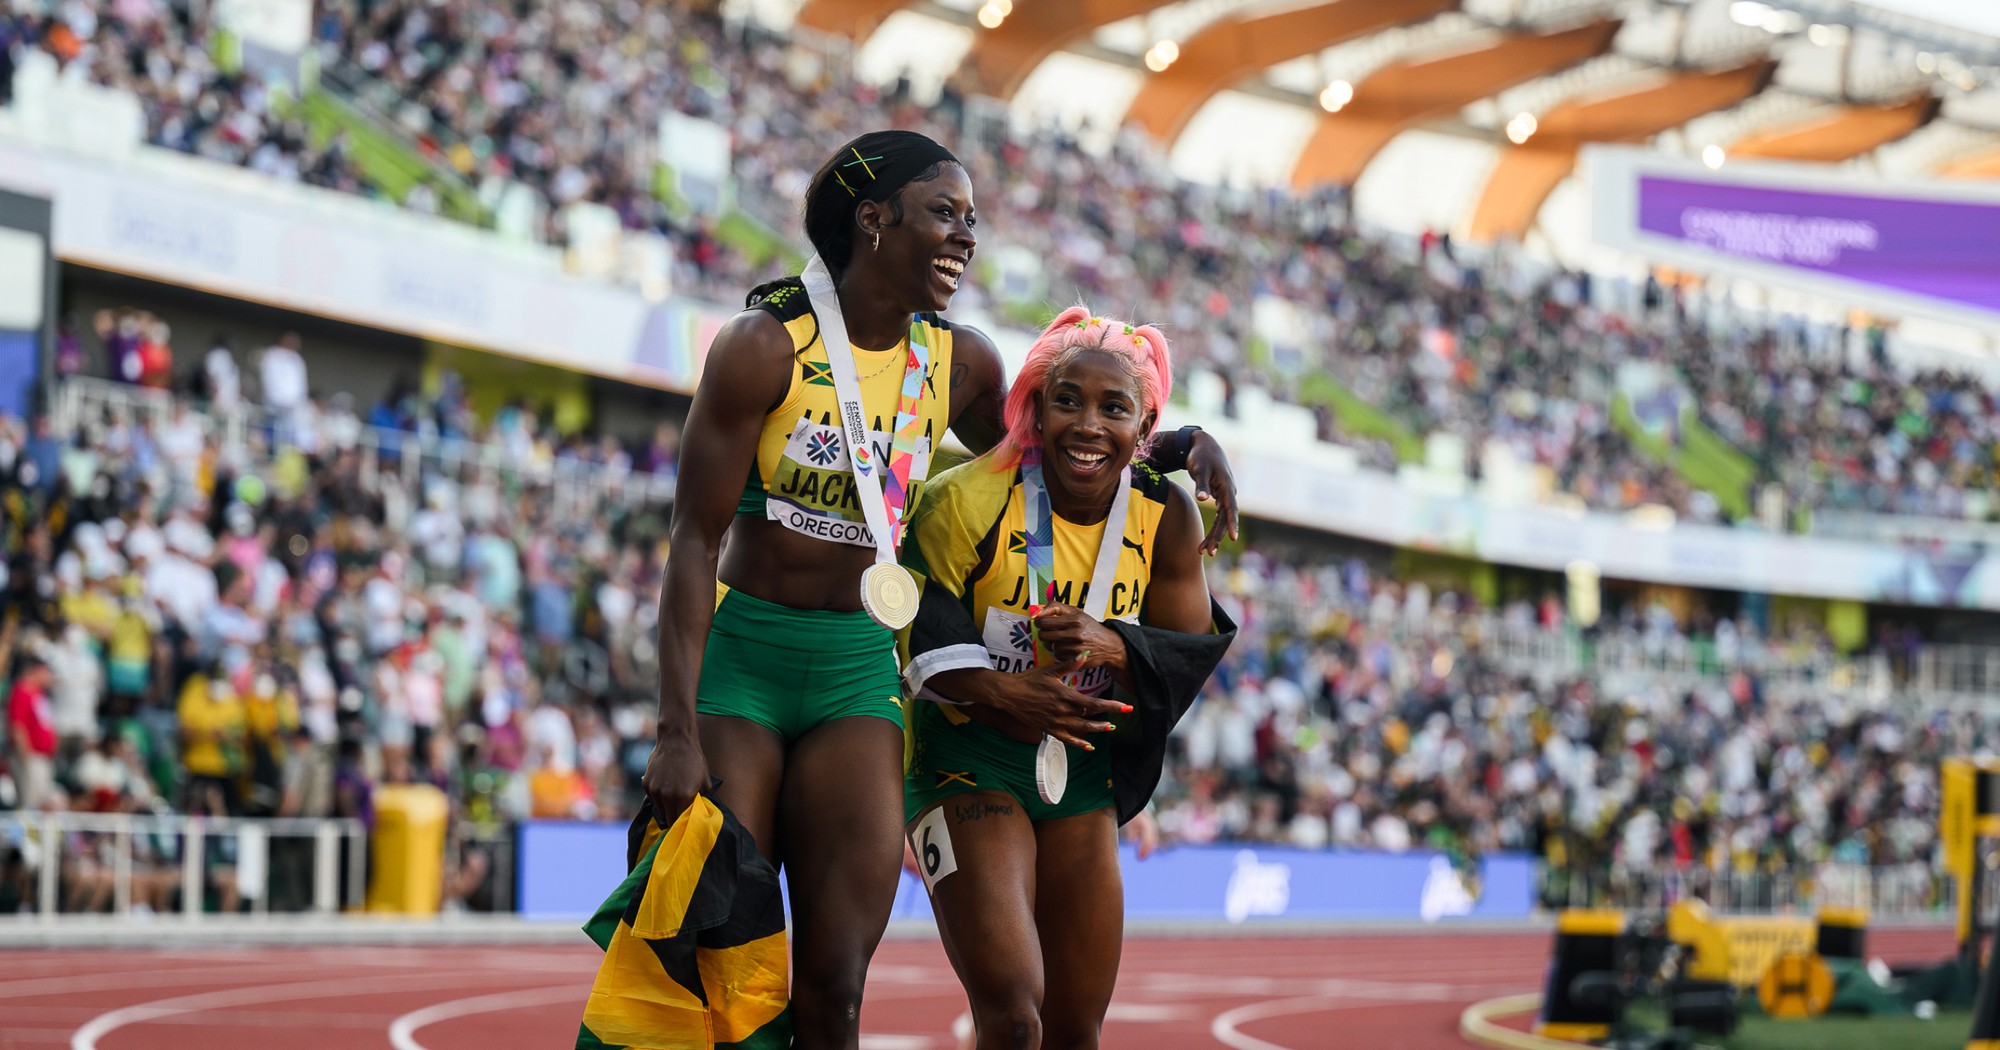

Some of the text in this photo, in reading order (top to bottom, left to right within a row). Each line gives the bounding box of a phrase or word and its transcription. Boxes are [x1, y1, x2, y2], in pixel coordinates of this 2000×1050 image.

[781, 468, 918, 515] JACKN
[790, 511, 877, 544] OREGON
[1002, 575, 1139, 616] JMACA
[922, 826, 941, 877] 6
